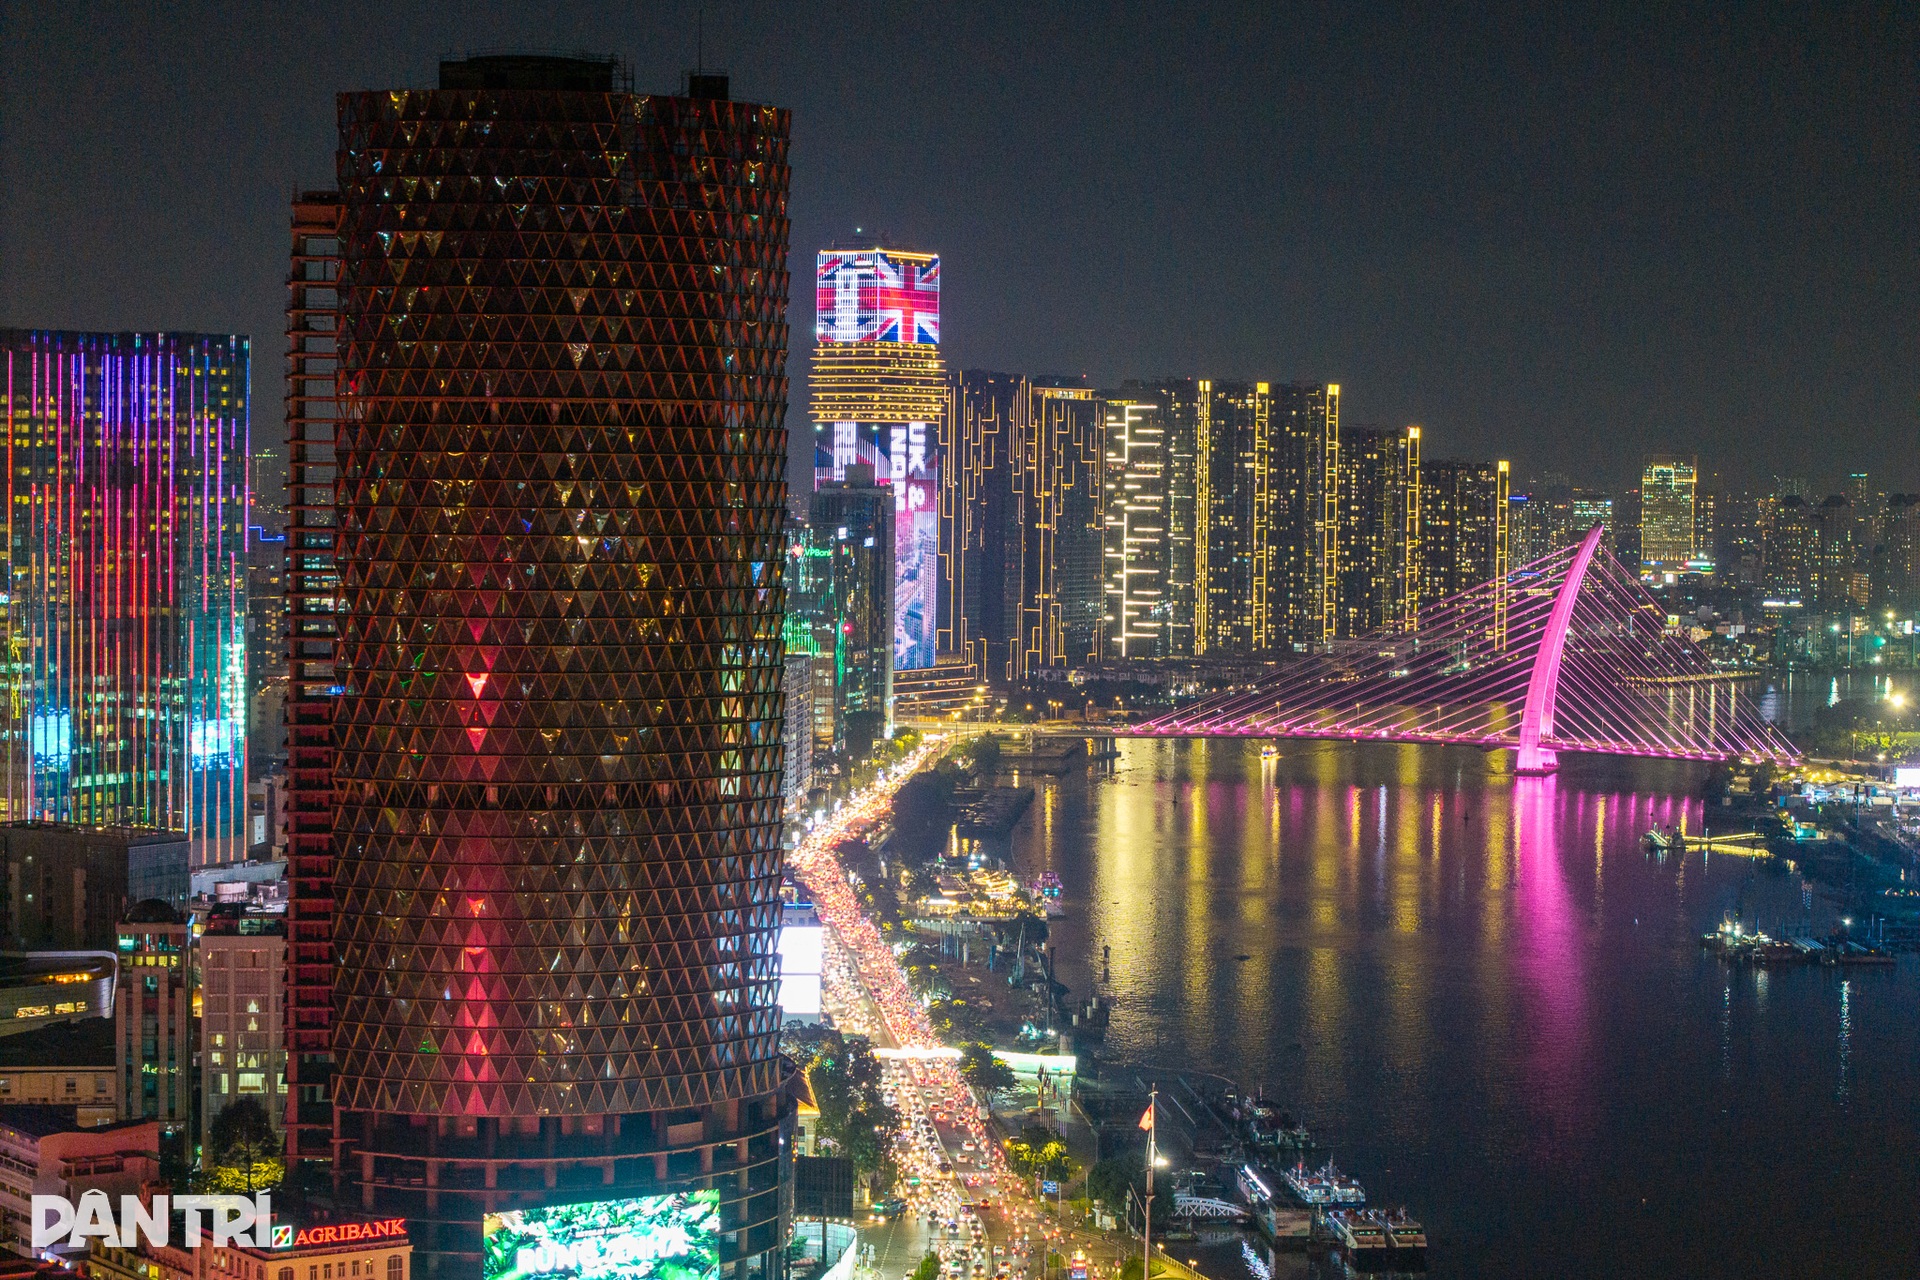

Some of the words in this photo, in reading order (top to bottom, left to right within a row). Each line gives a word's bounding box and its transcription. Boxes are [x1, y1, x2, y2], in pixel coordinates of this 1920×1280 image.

[909, 422, 926, 475] UK
[804, 547, 834, 557] VPBank
[293, 1217, 407, 1246] AGRIBANK
